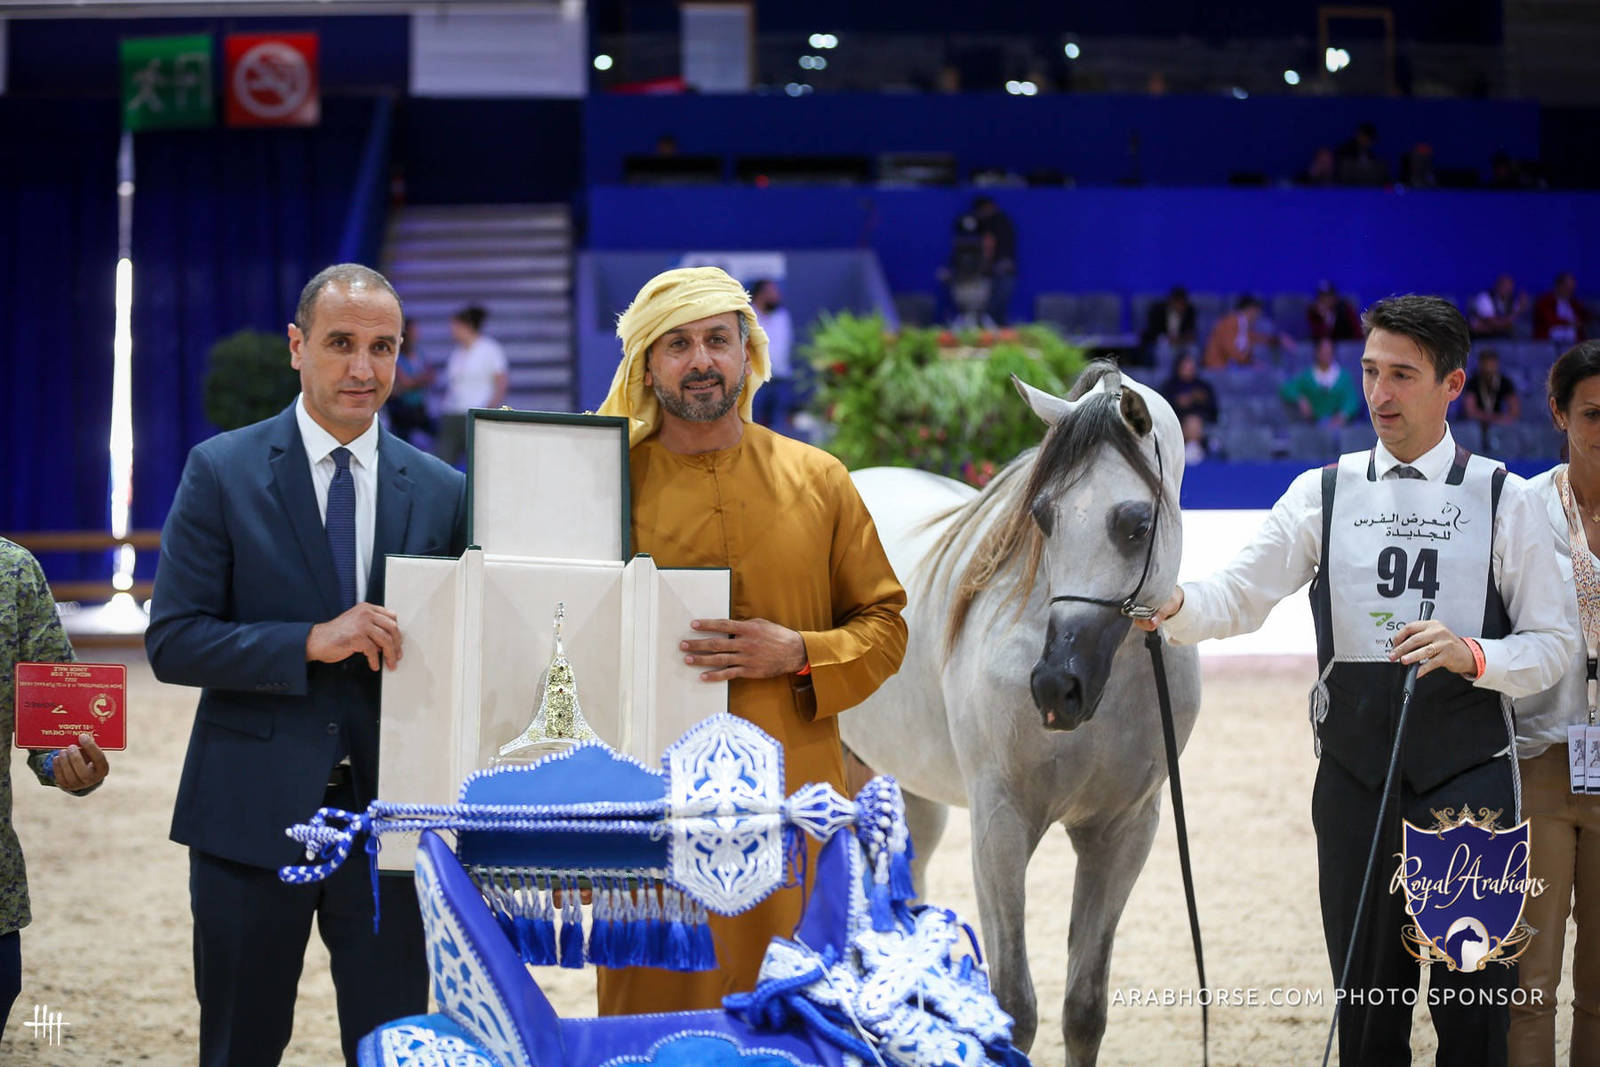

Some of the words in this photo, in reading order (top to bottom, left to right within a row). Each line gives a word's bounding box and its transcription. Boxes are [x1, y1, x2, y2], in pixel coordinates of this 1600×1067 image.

[1353, 513, 1399, 527] الفرس
[1401, 512, 1451, 527] معرض
[1386, 526, 1451, 541] للجديدة
[1376, 546, 1440, 599] 94
